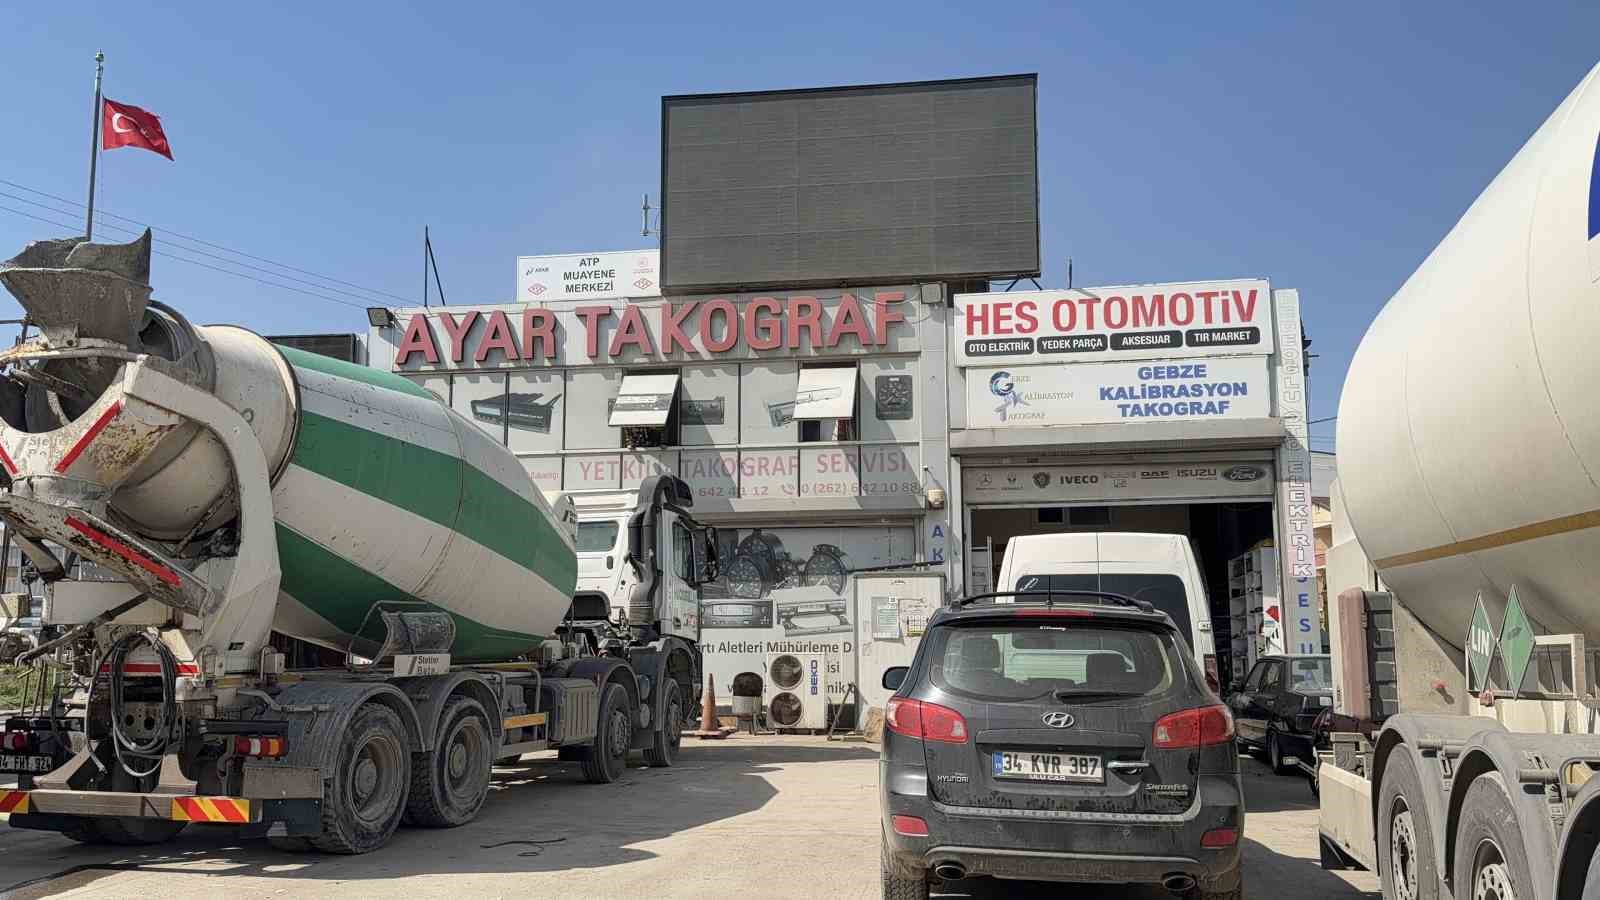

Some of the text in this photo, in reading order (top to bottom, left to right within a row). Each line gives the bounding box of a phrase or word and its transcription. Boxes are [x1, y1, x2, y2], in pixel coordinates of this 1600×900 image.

[579, 257, 600, 267] ATP
[563, 269, 616, 281] MUAYENE
[565, 281, 613, 293] MERKEZİ
[966, 300, 1039, 336] HES
[395, 291, 906, 364] AYAR TAKOGRAF
[1121, 334, 1171, 346] AKSESUAR
[1194, 330, 1251, 343] TIR MARKET
[969, 339, 1030, 353] OTO ELEKTRİK
[1042, 338, 1103, 350] YEDEK PARÇA
[1137, 364, 1207, 381] GEBZE
[1099, 382, 1248, 401] KALİBRASYON
[1117, 400, 1229, 418] TAKOGRAF
[682, 454, 799, 479] TAKOGRAF
[1177, 468, 1217, 477] ISUZU
[1060, 475, 1099, 485] IVECO
[718, 640, 763, 653] Aletleri
[766, 640, 839, 653] Mühürleme
[1003, 754, 1023, 772] 34
[1069, 756, 1099, 776] 387
